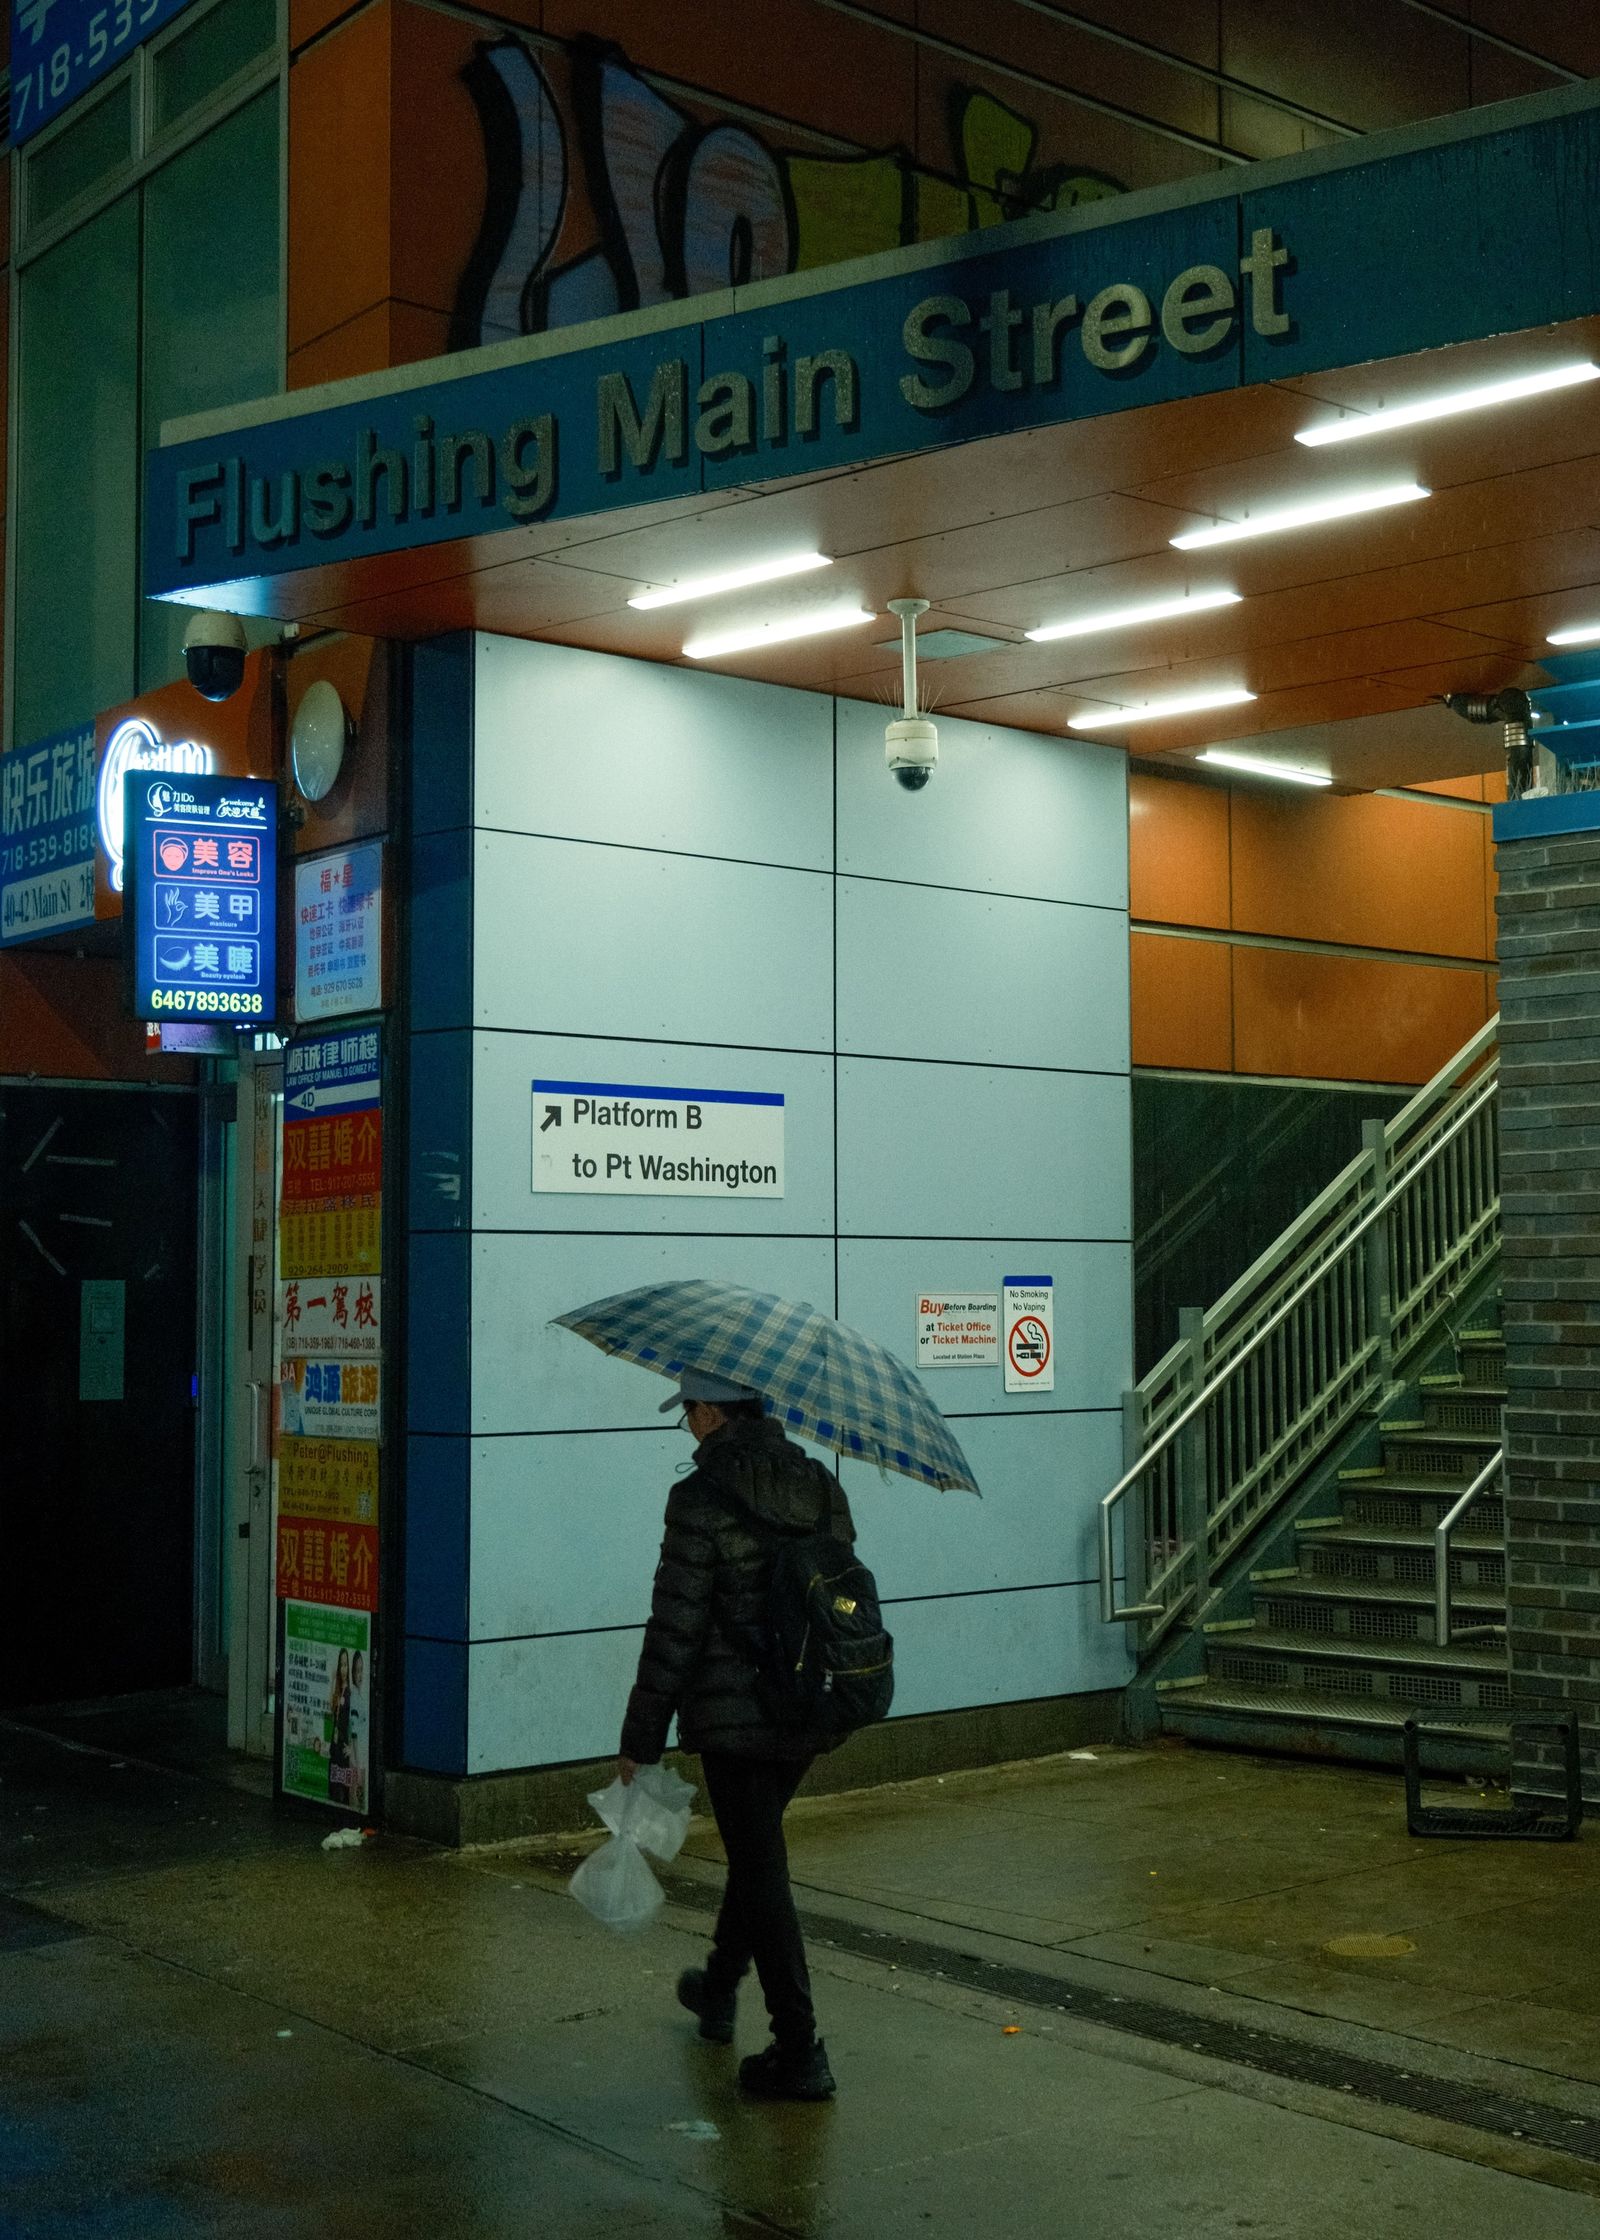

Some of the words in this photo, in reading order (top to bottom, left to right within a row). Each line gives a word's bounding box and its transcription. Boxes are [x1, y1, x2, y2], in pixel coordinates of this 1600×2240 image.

[176, 411, 558, 562] Flushing
[597, 335, 857, 477] Main
[899, 227, 1291, 409] Street
[193, 838, 253, 868] 美容
[192, 868, 217, 876] Improve
[218, 868, 235, 876] One's
[32, 884, 58, 920] Main
[60, 879, 71, 914] St
[194, 891, 253, 921] 美甲
[194, 942, 253, 974] 美睫
[201, 971, 222, 980] Beauty
[151, 989, 262, 1013] 6467893638
[286, 1076, 297, 1087] LAW
[298, 1072, 314, 1085] OFFICE
[314, 1070, 322, 1082] OF
[322, 1068, 343, 1081] MANUEL
[301, 1091, 315, 1108] 4D
[573, 1098, 677, 1129] Platform
[686, 1104, 702, 1129] B
[572, 1153, 597, 1178] to
[606, 1153, 632, 1179] Pt
[639, 1154, 777, 1189] Washington
[1009, 1290, 1019, 1298] No
[1020, 1290, 1049, 1300] Smoking
[920, 1299, 944, 1316] Buy
[944, 1303, 966, 1312] Before
[967, 1303, 997, 1312] Boarding
[1013, 1303, 1022, 1311] No
[1023, 1303, 1046, 1312] Vaping
[926, 1322, 935, 1332] at
[937, 1322, 964, 1332] Ticket
[966, 1322, 991, 1332] Office
[920, 1336, 930, 1345] or
[932, 1335, 960, 1345] Ticket
[961, 1335, 997, 1344] Machine
[341, 1407, 363, 1417] CULTURE
